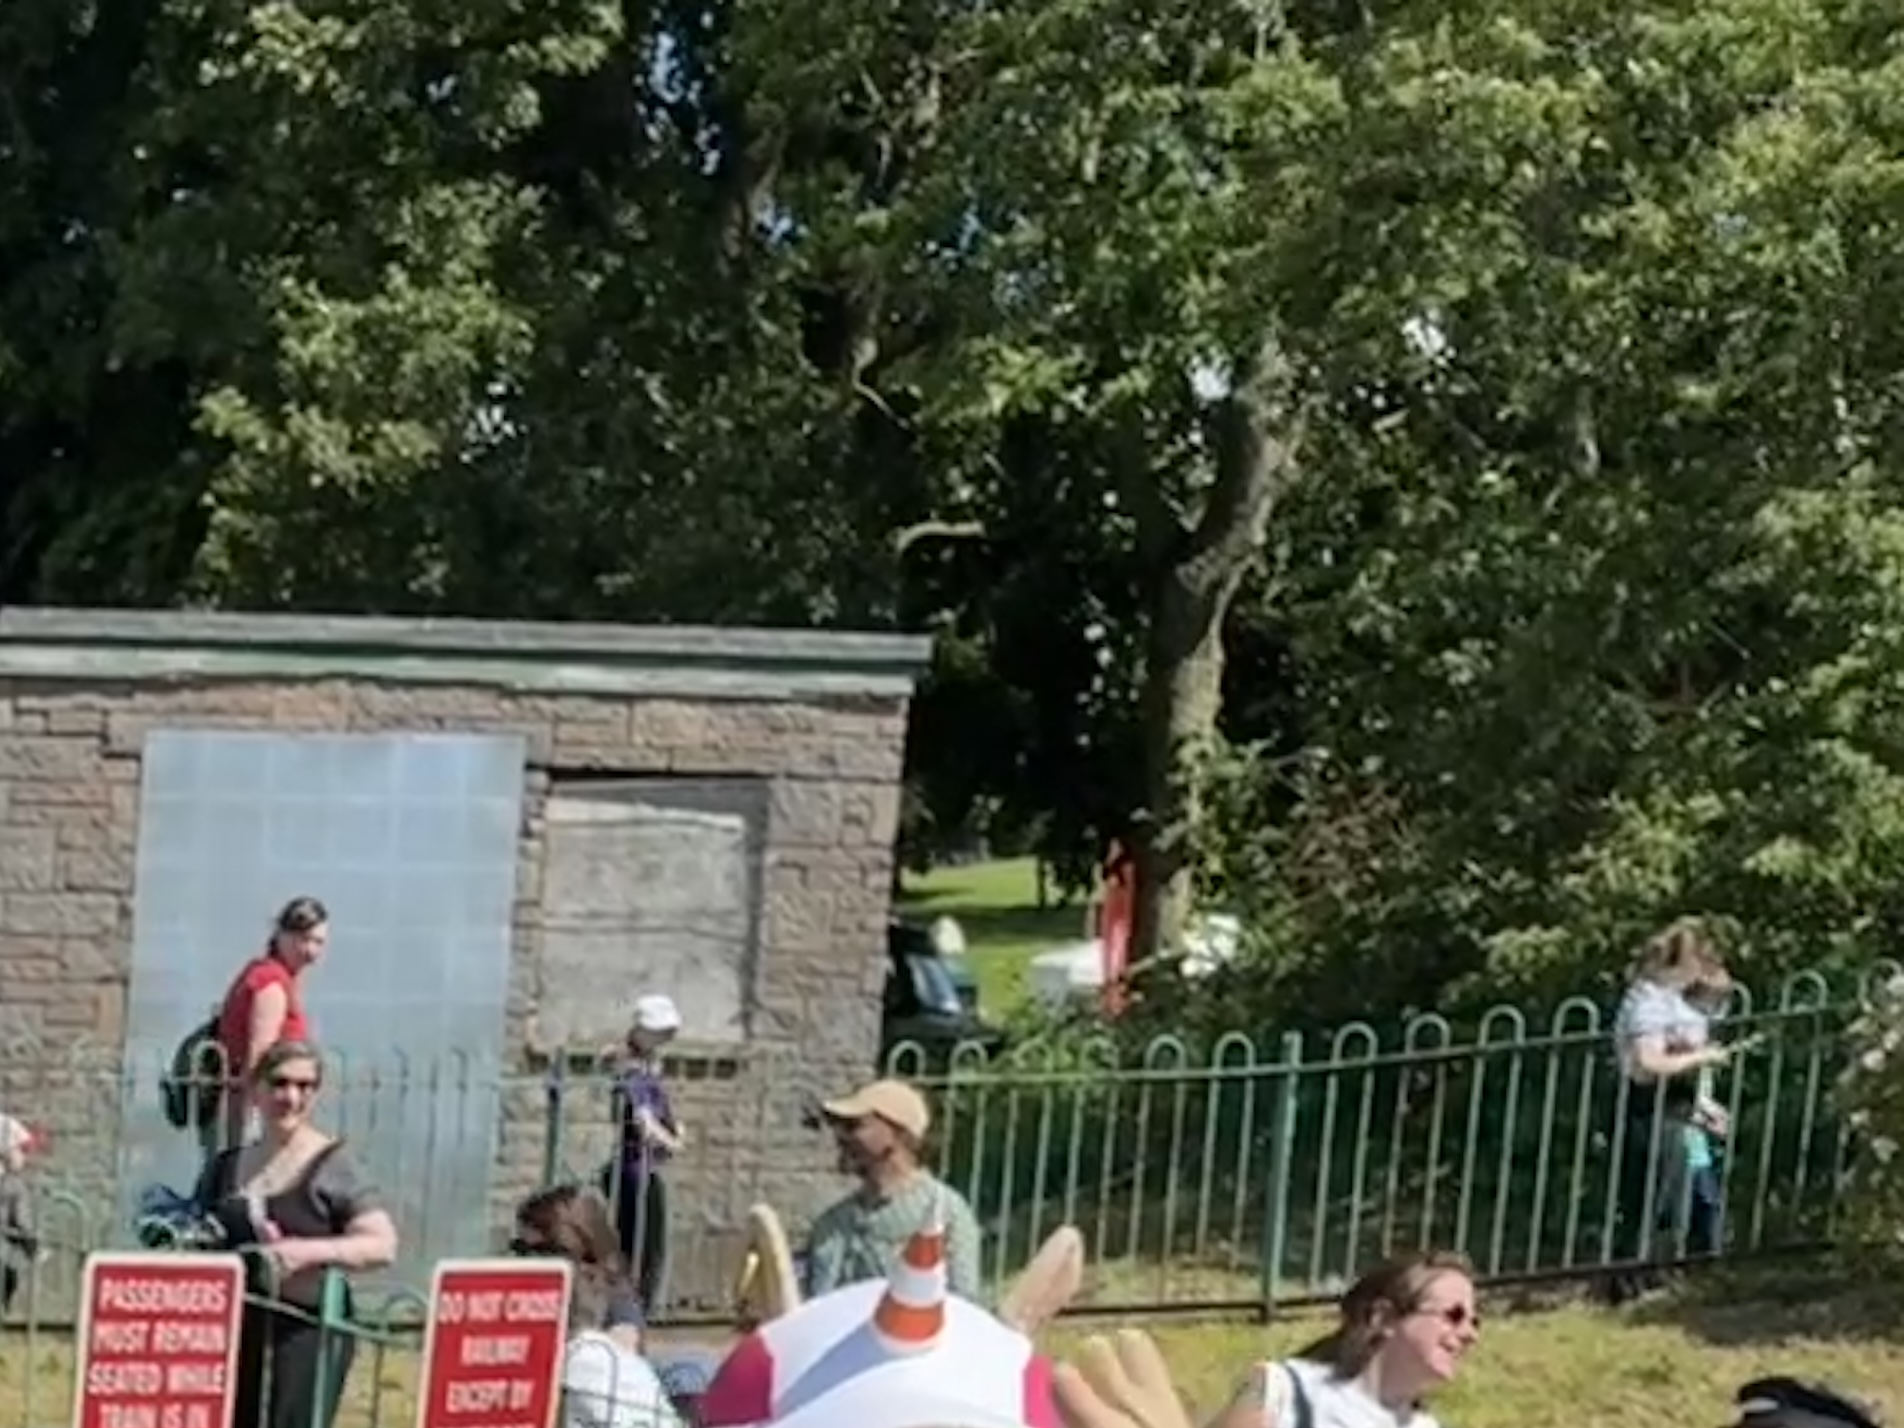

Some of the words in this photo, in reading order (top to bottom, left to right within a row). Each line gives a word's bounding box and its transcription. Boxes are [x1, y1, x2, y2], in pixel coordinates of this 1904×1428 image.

[99, 1278, 227, 1313] PASSENGERS
[439, 1293, 465, 1322] DO
[468, 1292, 503, 1321] NOT
[505, 1291, 560, 1321] CROSS
[93, 1320, 149, 1353] MUST
[152, 1320, 226, 1354] REMAIN
[460, 1335, 532, 1366] RAILWAY
[88, 1361, 162, 1394] SEATED
[167, 1363, 225, 1394] WHILE
[446, 1380, 508, 1413] EXCEPT
[510, 1379, 536, 1411] BY
